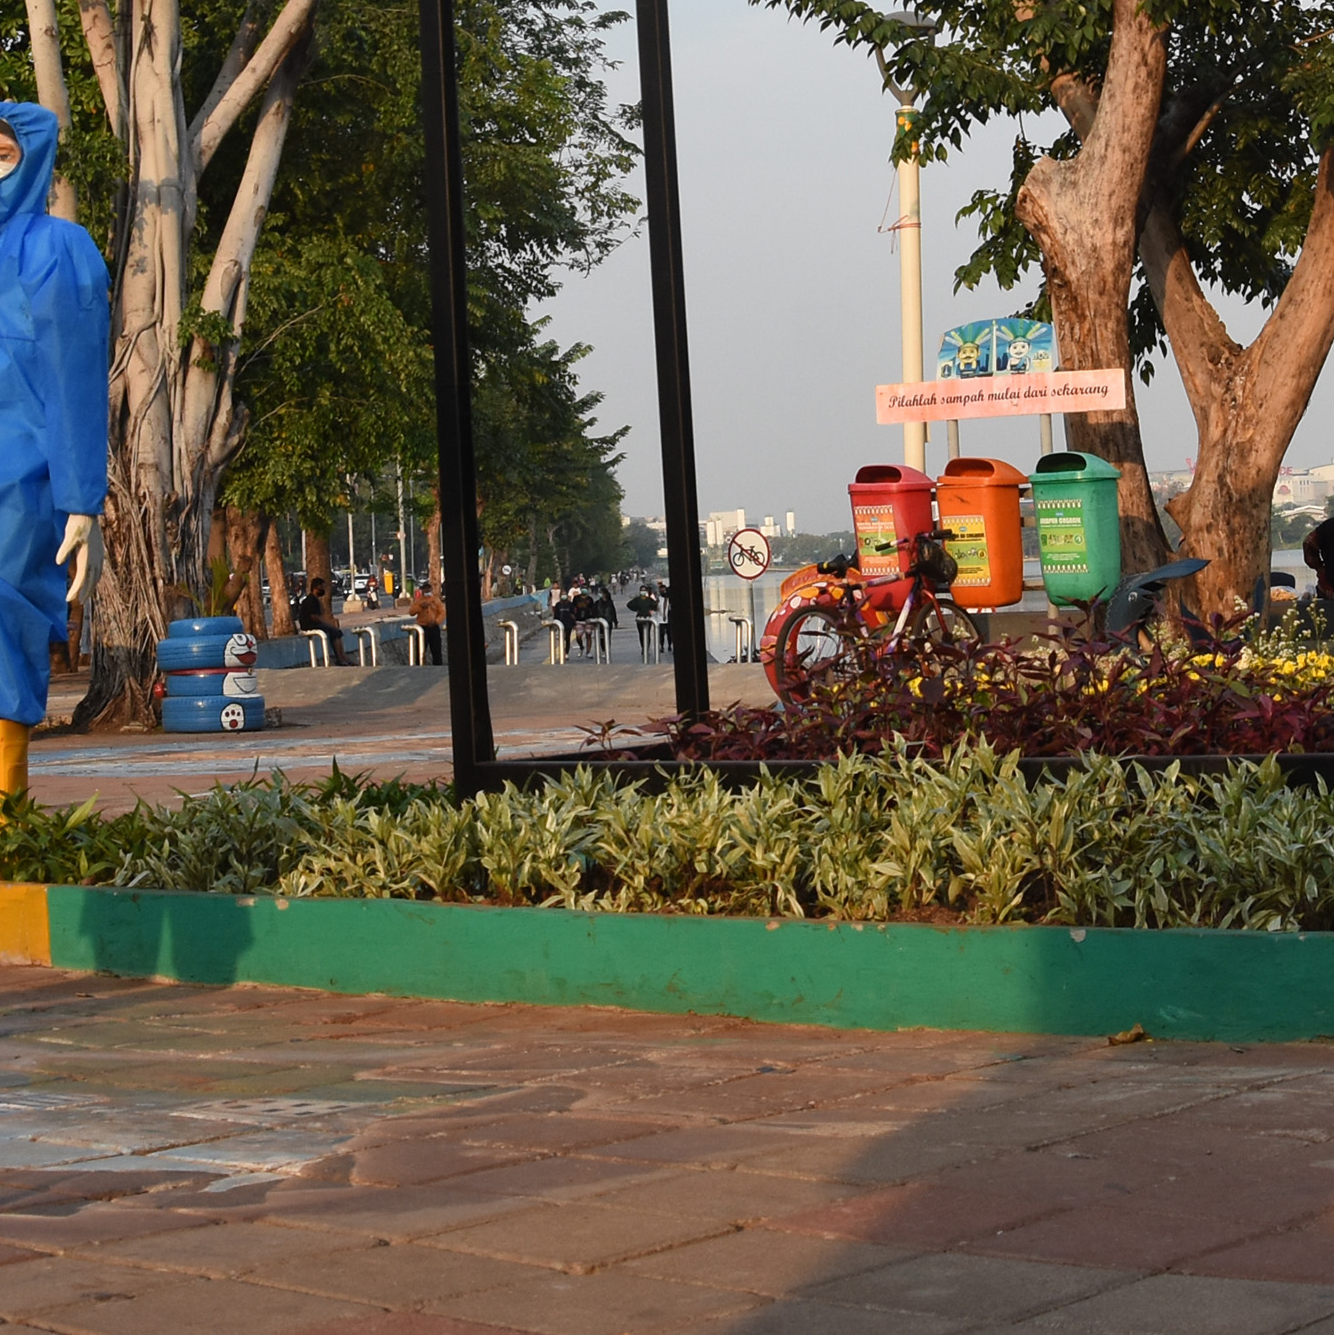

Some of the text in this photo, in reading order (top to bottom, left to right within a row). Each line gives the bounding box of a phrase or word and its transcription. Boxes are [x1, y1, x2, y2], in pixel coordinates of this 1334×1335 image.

[888, 383, 1108, 409] Pilahlah sampah mulai dari sekarang
